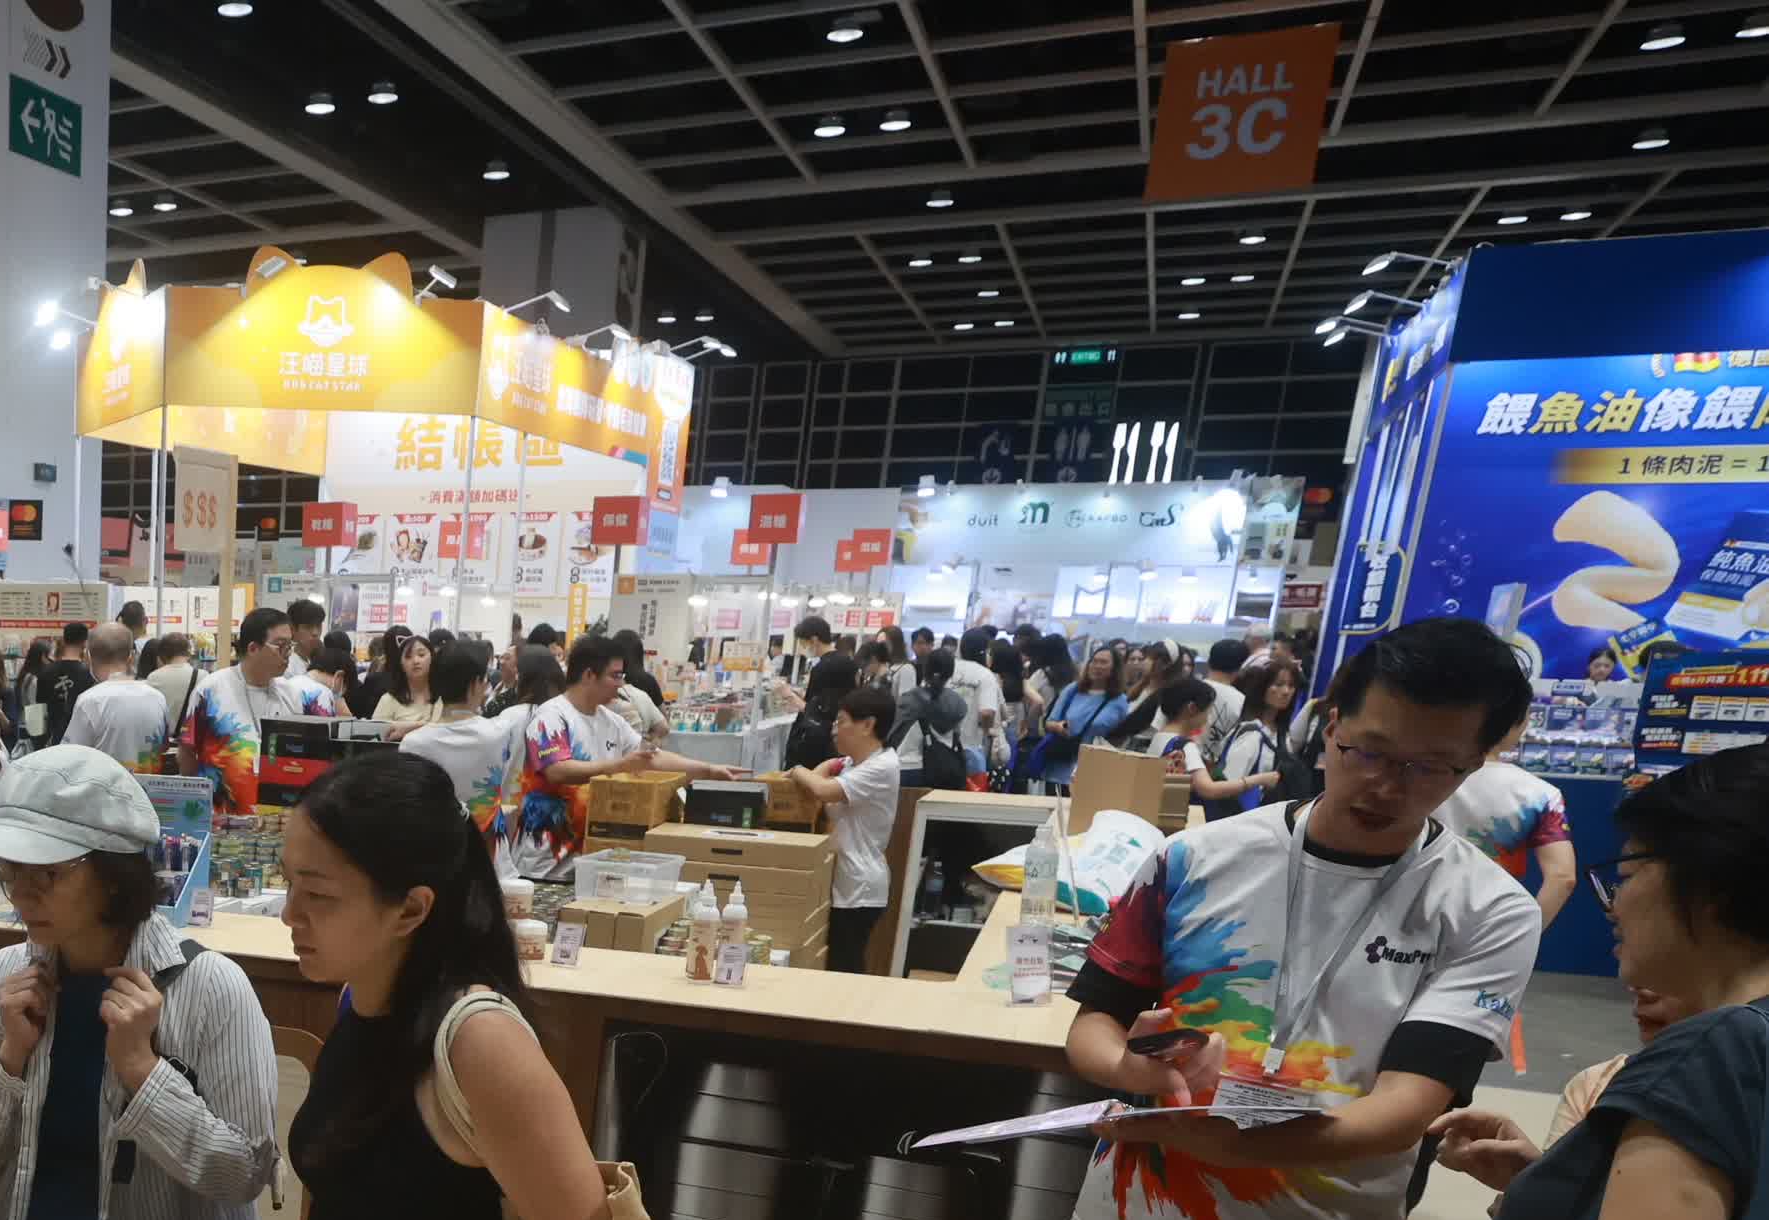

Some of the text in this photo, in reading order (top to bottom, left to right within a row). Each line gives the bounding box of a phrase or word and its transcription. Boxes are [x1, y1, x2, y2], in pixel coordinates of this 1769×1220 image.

[1197, 62, 1295, 99] HALL
[1185, 97, 1288, 160] 3C
[1641, 454, 1724, 477] 條肉泥
